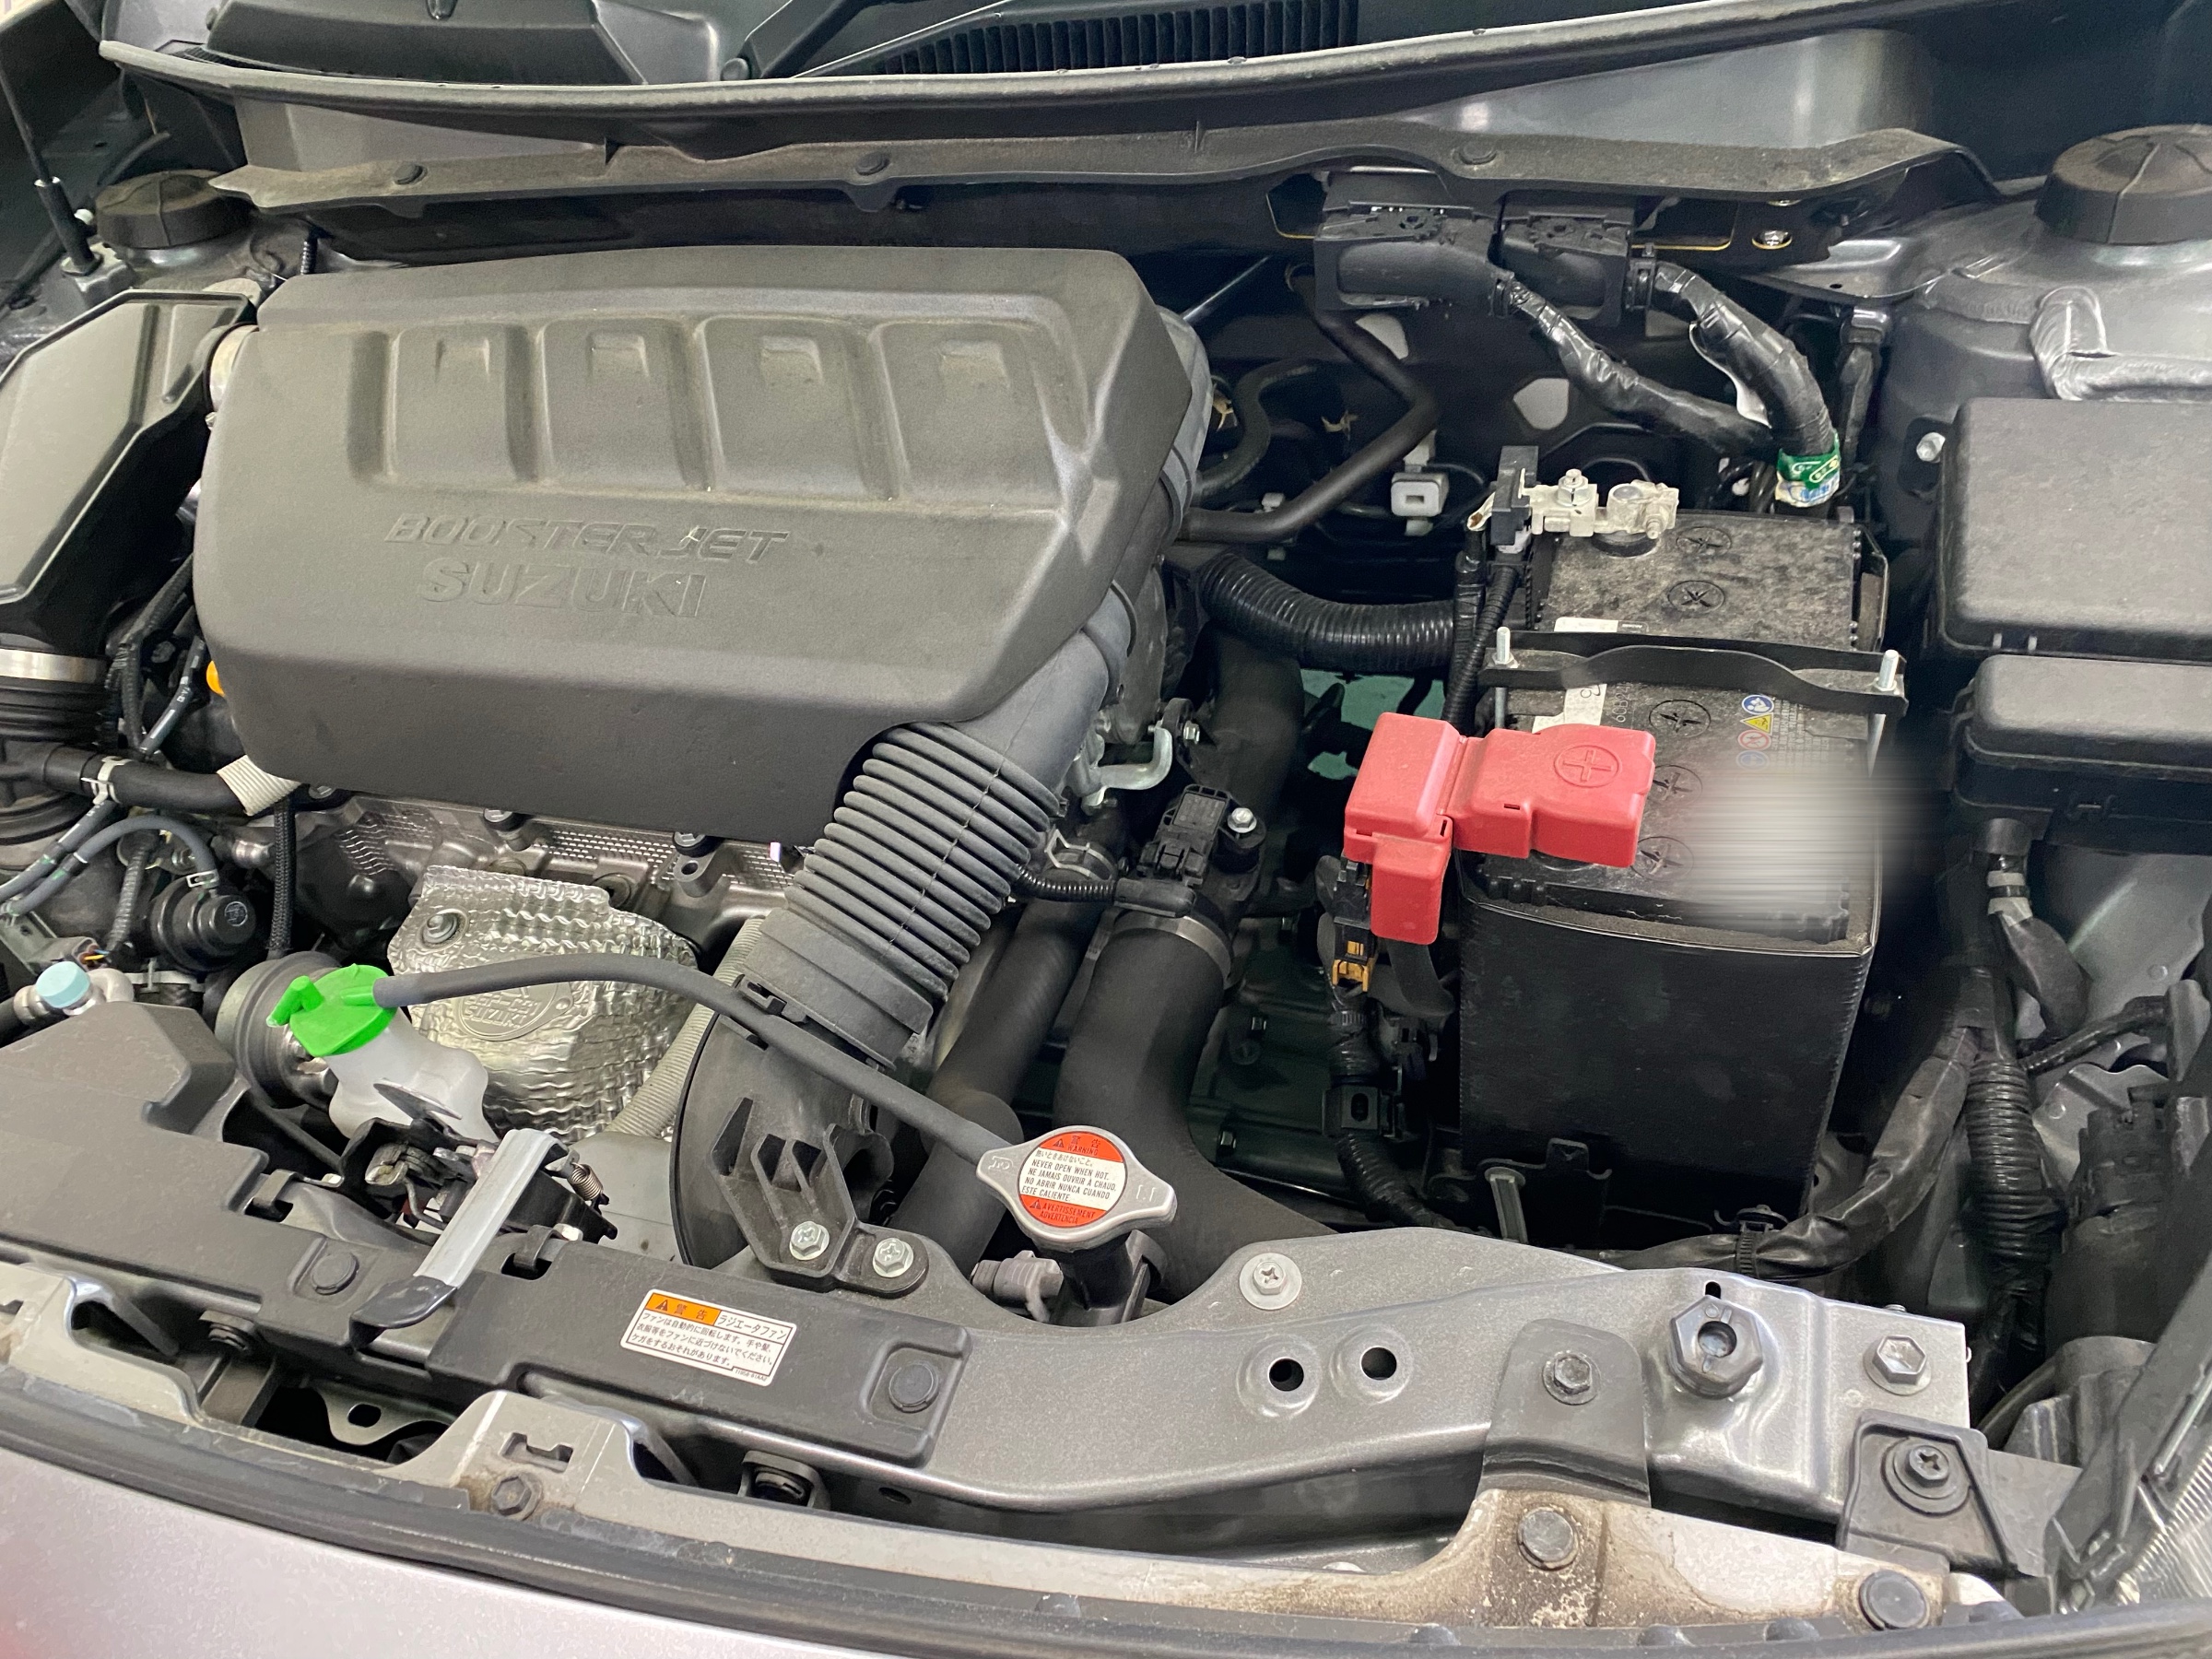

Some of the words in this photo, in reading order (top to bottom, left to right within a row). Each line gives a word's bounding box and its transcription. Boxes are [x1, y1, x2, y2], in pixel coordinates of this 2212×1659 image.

[418, 557, 706, 618] SUZUKI
[463, 1006, 527, 1029] SUZUKI
[1067, 1144, 1099, 1156] WARNING
[1028, 1168, 1037, 1176] NE
[1038, 1170, 1062, 1181] JAMAIS
[1062, 1174, 1086, 1185] OUVRIR
[1031, 1159, 1053, 1170] NEVER
[1053, 1163, 1072, 1173] OPEN
[1074, 1167, 1093, 1177] WHEN
[1021, 1186, 1037, 1195] ESTE
[1025, 1177, 1034, 1185] NO
[1036, 1179, 1056, 1190] ABRIR
[1057, 1182, 1080, 1194] NUNCA
[1082, 1187, 1111, 1200] CUANDO
[1040, 1210, 1079, 1224] ADVERTENCIA
[1042, 1203, 1096, 1218] AVERTISSEMENT
[717, 1314, 787, 1340] ラジエータファン
[631, 1333, 730, 1366] ケガをするおそれがあります。
